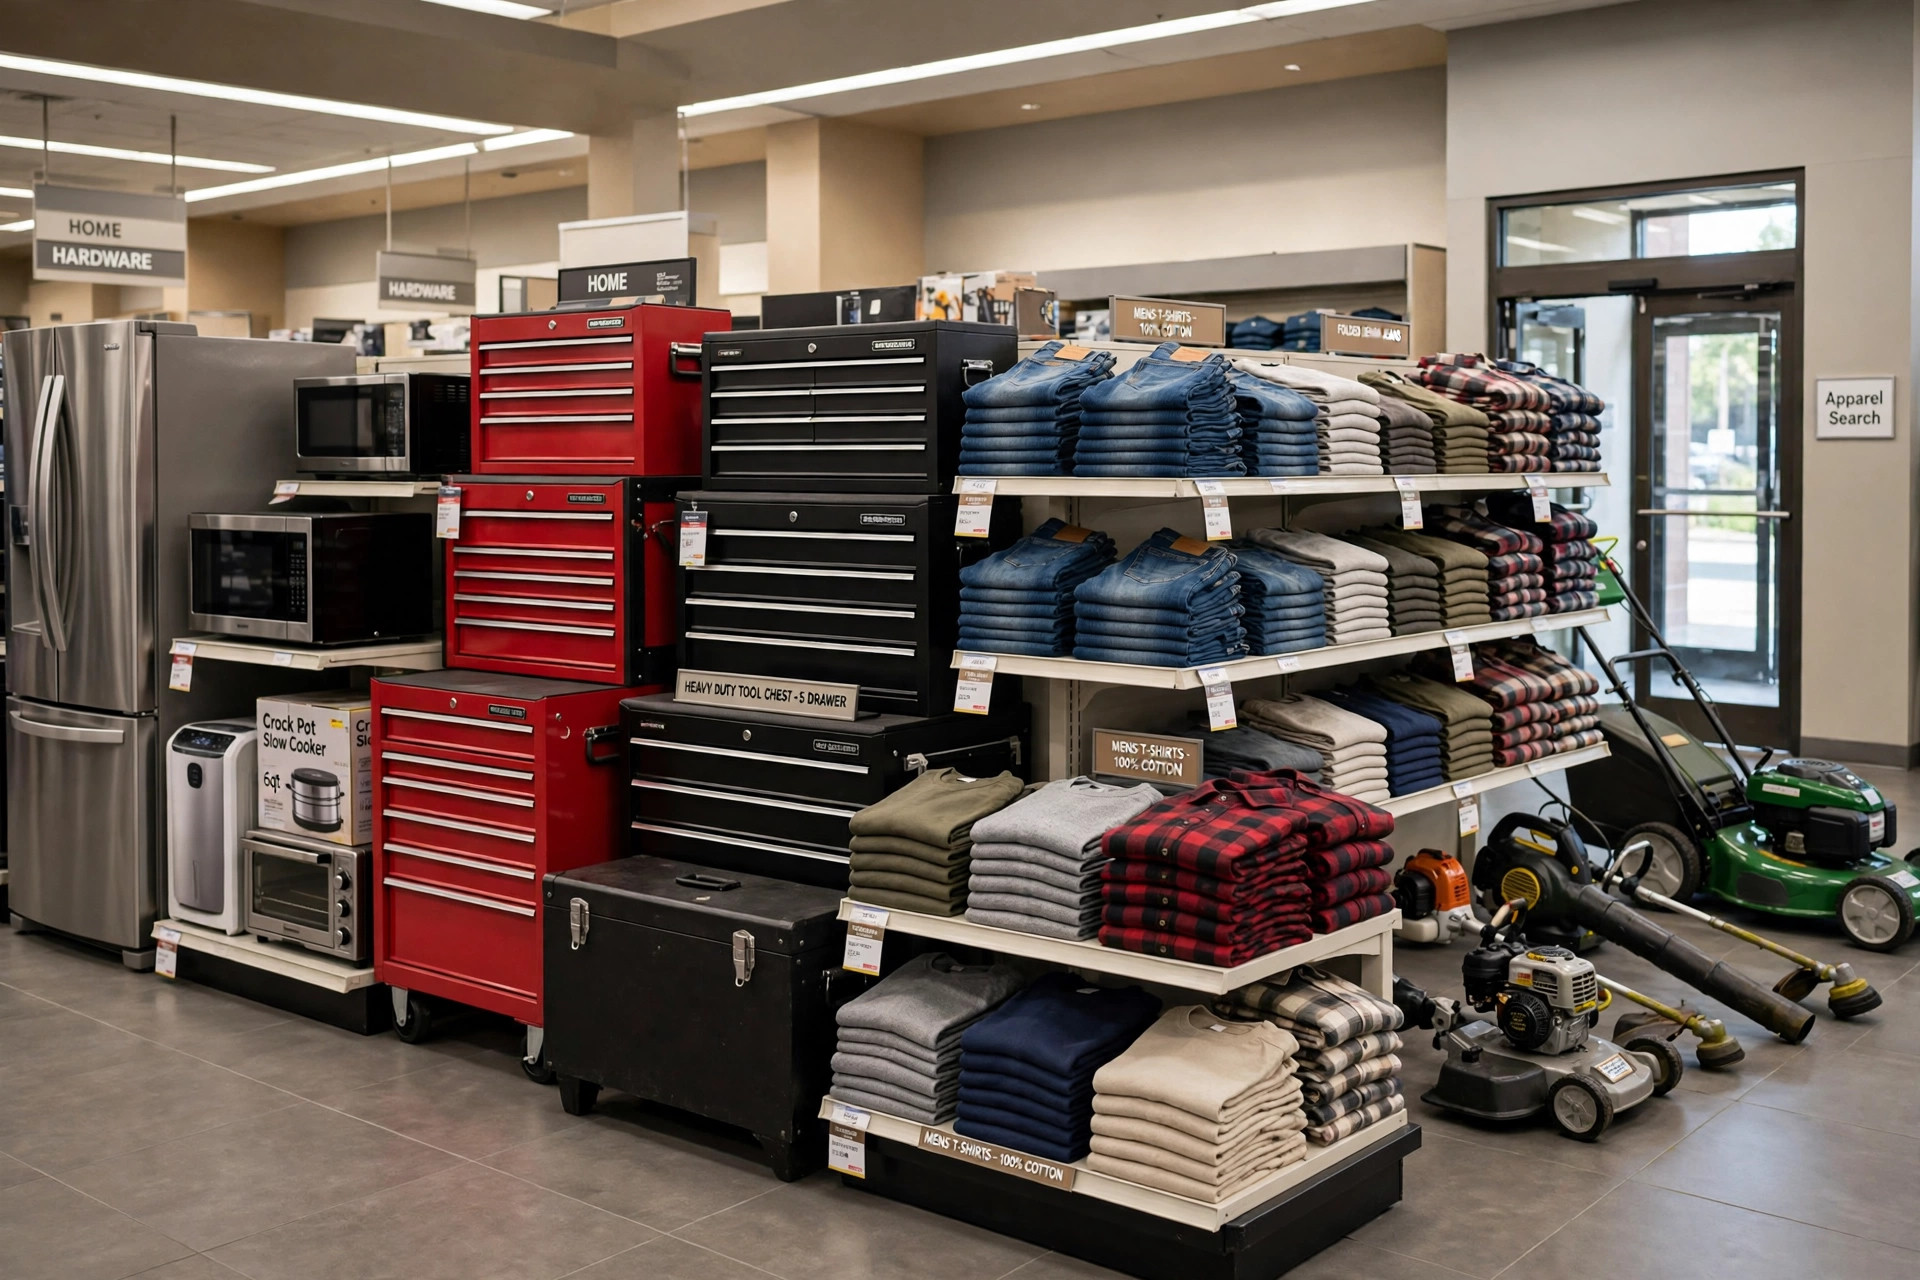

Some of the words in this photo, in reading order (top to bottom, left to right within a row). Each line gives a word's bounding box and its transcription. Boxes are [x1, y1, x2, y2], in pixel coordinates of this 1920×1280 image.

[69, 219, 122, 238] HOME
[53, 246, 152, 270] HARDWARE
[389, 281, 456, 300] HARDWARE
[588, 272, 627, 292] HOME
[1133, 306, 1157, 320] MENS
[1158, 309, 1191, 322] T-SHIRTS
[1825, 390, 1883, 408] Apparel
[1829, 410, 1881, 425] Search
[685, 681, 713, 695] HEAVY
[714, 683, 737, 696] DUTY
[739, 685, 762, 700] TOOL
[764, 687, 792, 702] CHEST
[807, 691, 847, 708] DRAWER
[263, 713, 294, 733] Crock
[297, 718, 316, 735] Pot
[263, 732, 287, 750] Slow
[289, 736, 326, 756] Cooker
[1111, 740, 1138, 755] MENS
[1140, 744, 1185, 760] T-SHIRTS
[1114, 756, 1139, 770] 100%
[1141, 759, 1183, 777] COTTON
[263, 771, 281, 793] 6qt
[924, 1131, 951, 1149] MENS
[952, 1139, 992, 1161] T-SHIRTS
[1000, 1153, 1023, 1170] 100%
[1024, 1160, 1064, 1182] COTTON
